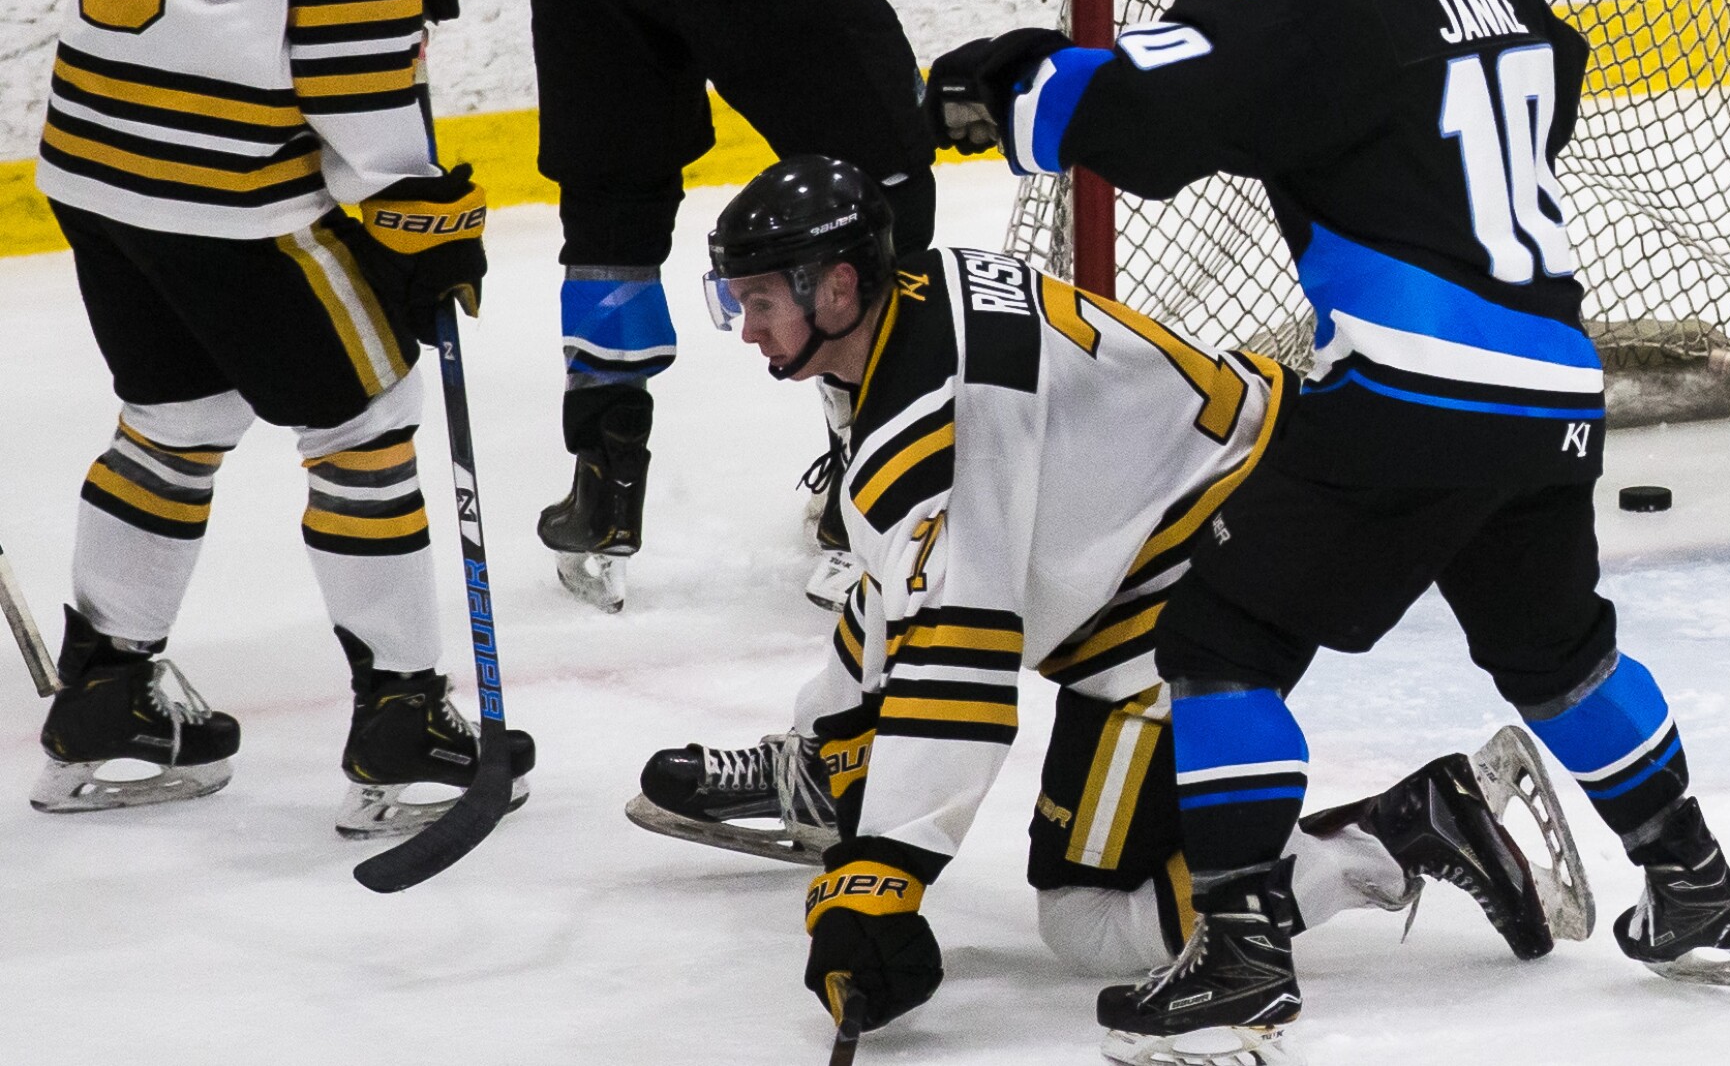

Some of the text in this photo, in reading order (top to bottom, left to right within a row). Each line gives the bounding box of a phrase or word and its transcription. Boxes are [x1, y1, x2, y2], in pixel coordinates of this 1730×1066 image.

[1438, 43, 1575, 285] 10
[960, 249, 1031, 315] RUSH
[1037, 271, 1249, 445] 7
[463, 558, 504, 722] BAUER
